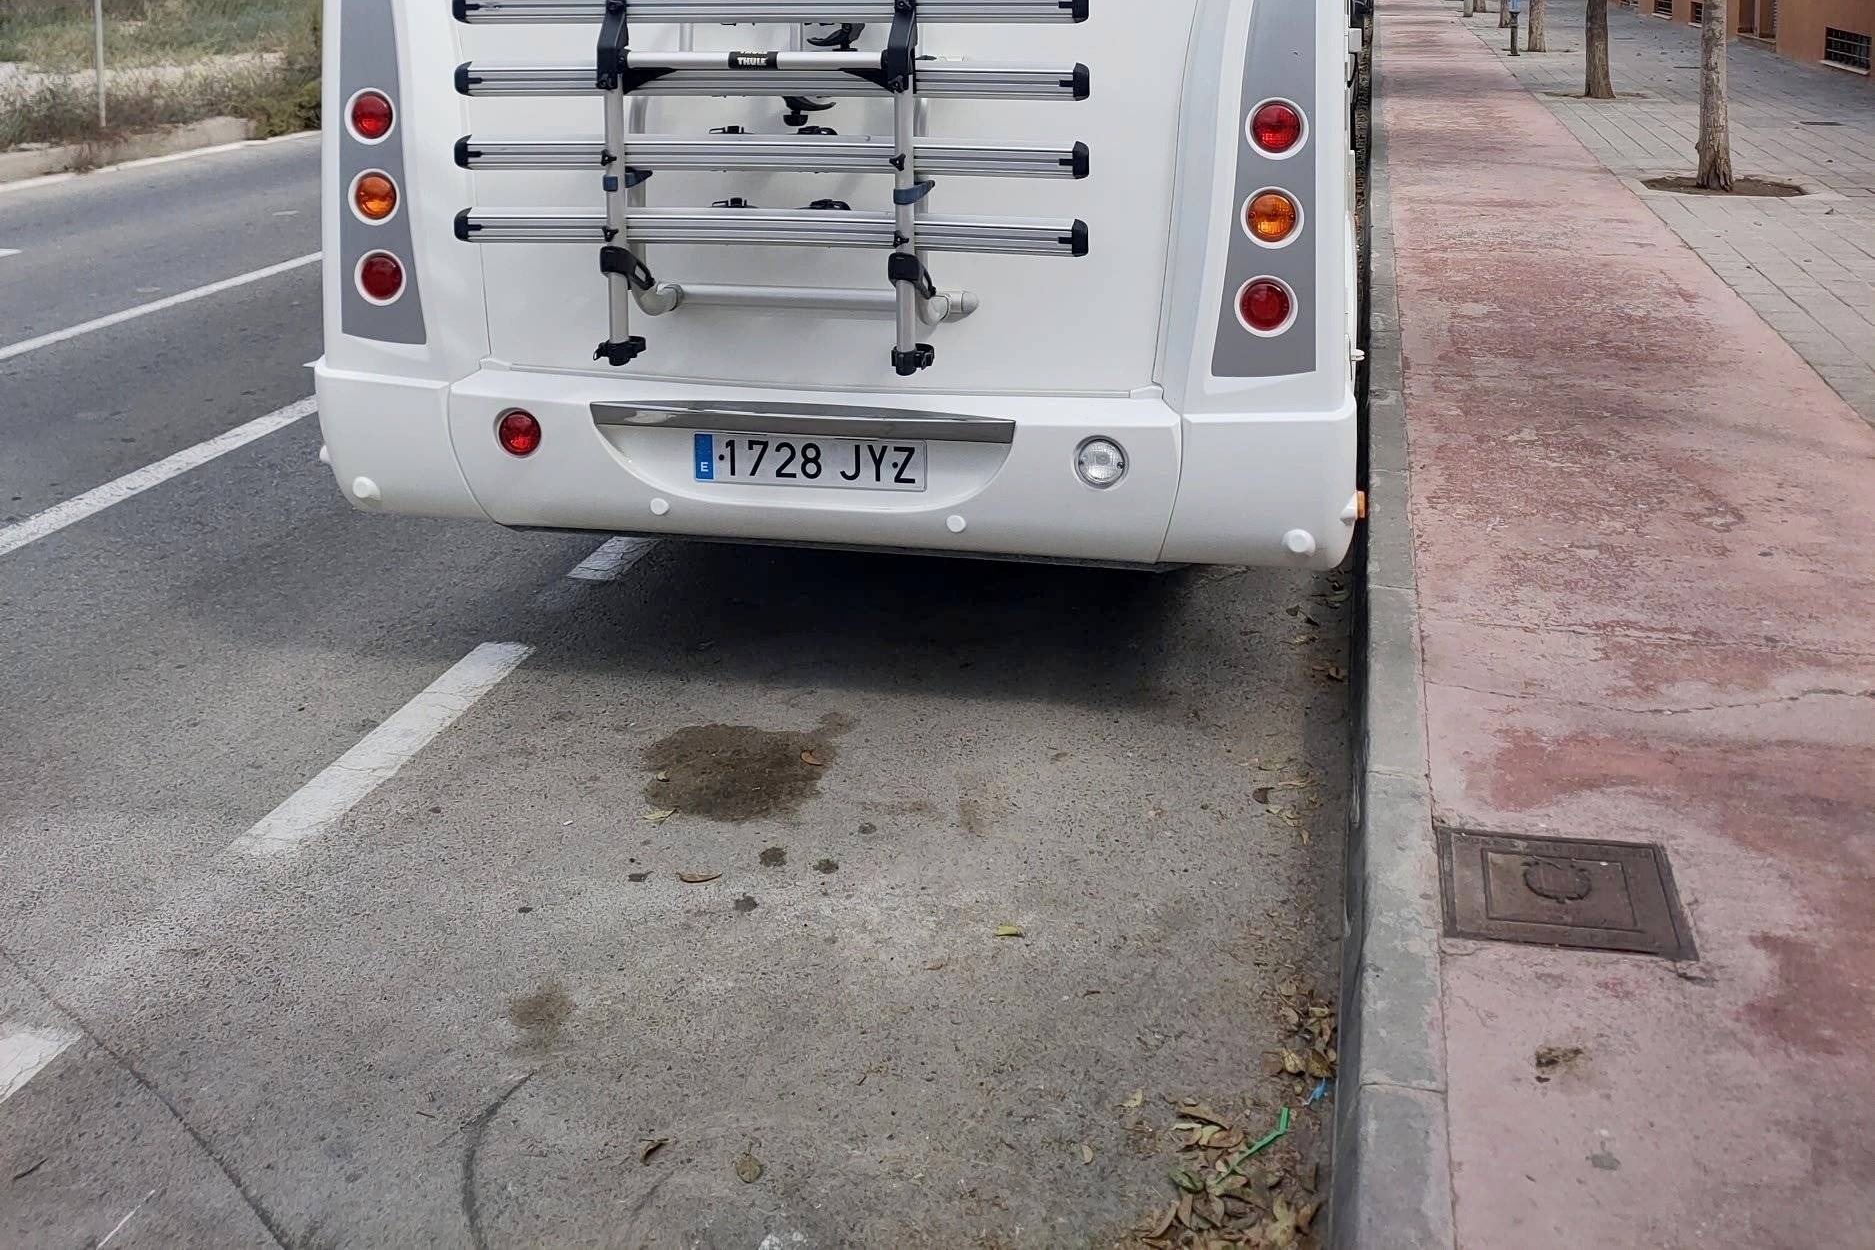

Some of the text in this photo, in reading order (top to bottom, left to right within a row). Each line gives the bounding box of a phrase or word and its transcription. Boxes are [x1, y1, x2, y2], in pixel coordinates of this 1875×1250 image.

[737, 56, 769, 66] THULE
[699, 439, 917, 484] E 1728 JYZ
